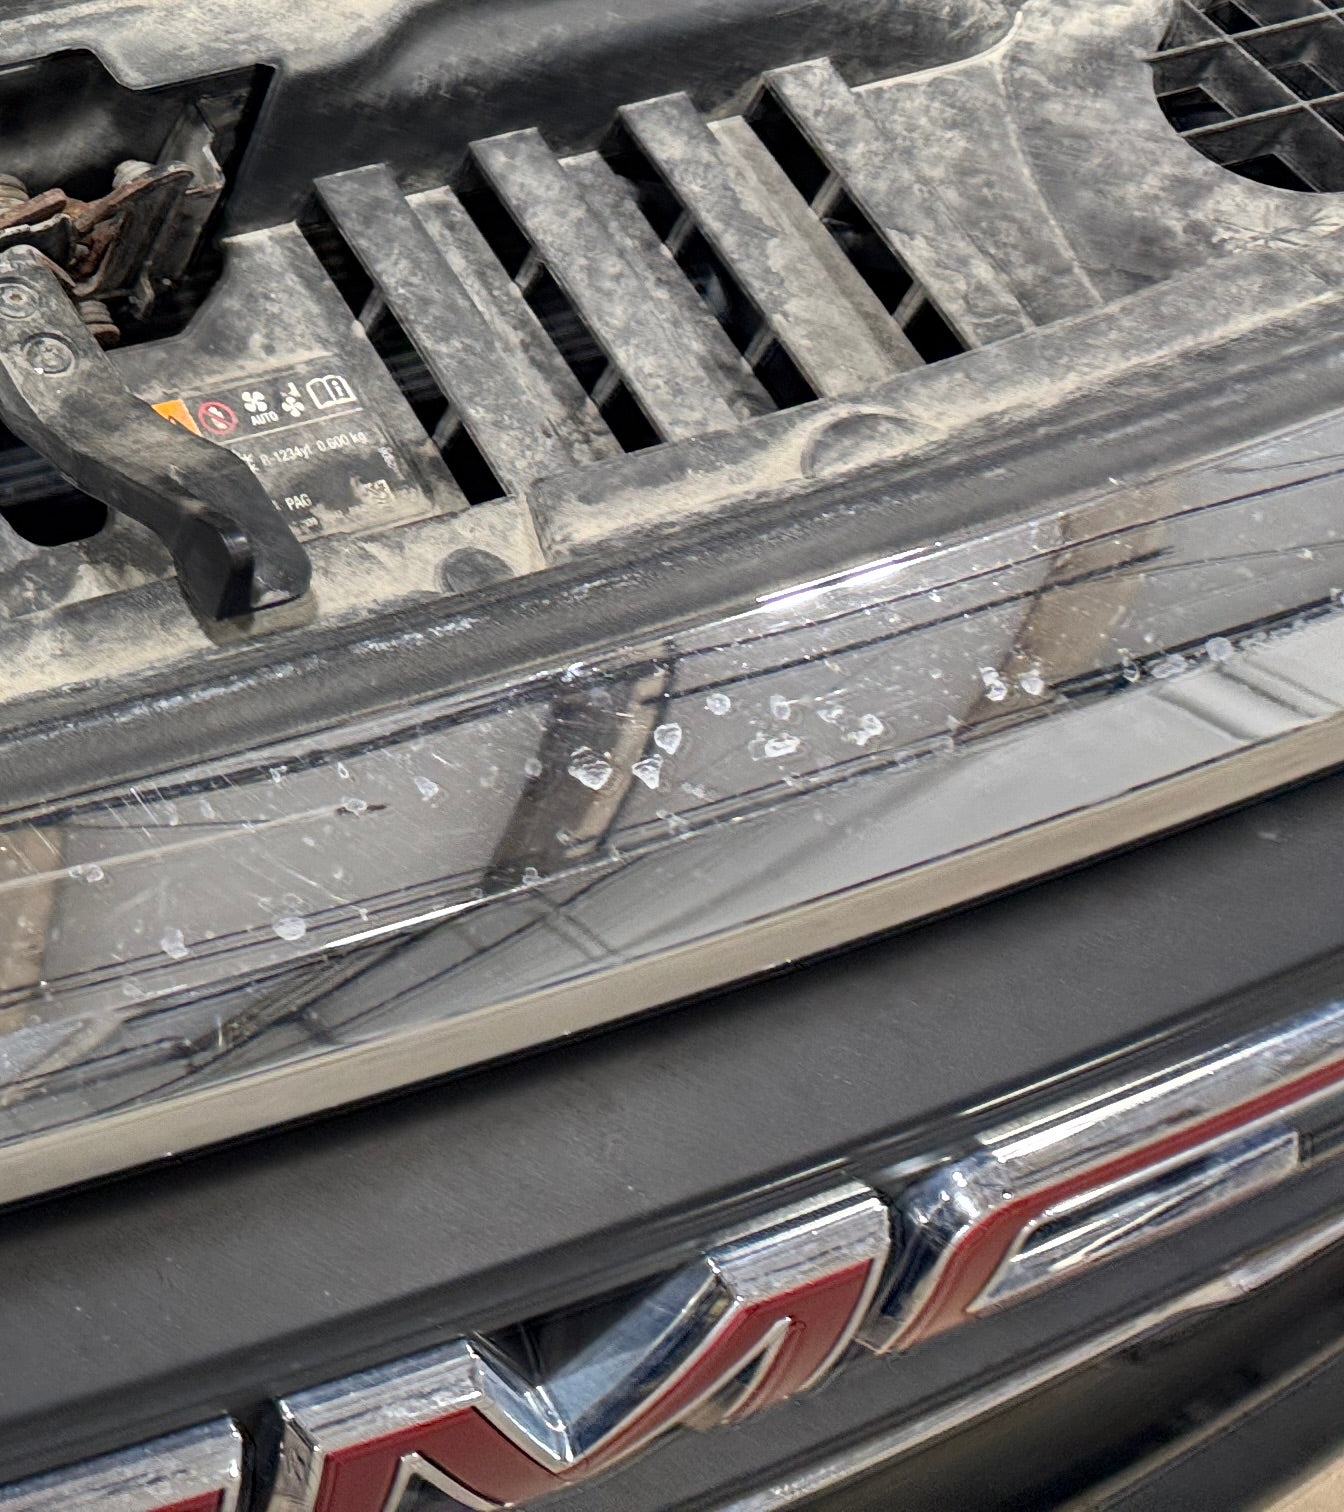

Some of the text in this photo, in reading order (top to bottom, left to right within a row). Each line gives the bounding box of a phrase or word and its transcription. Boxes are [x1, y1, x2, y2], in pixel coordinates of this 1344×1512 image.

[250, 410, 279, 426] AUTO
[349, 431, 368, 446] kg
[284, 493, 312, 511] PAG
